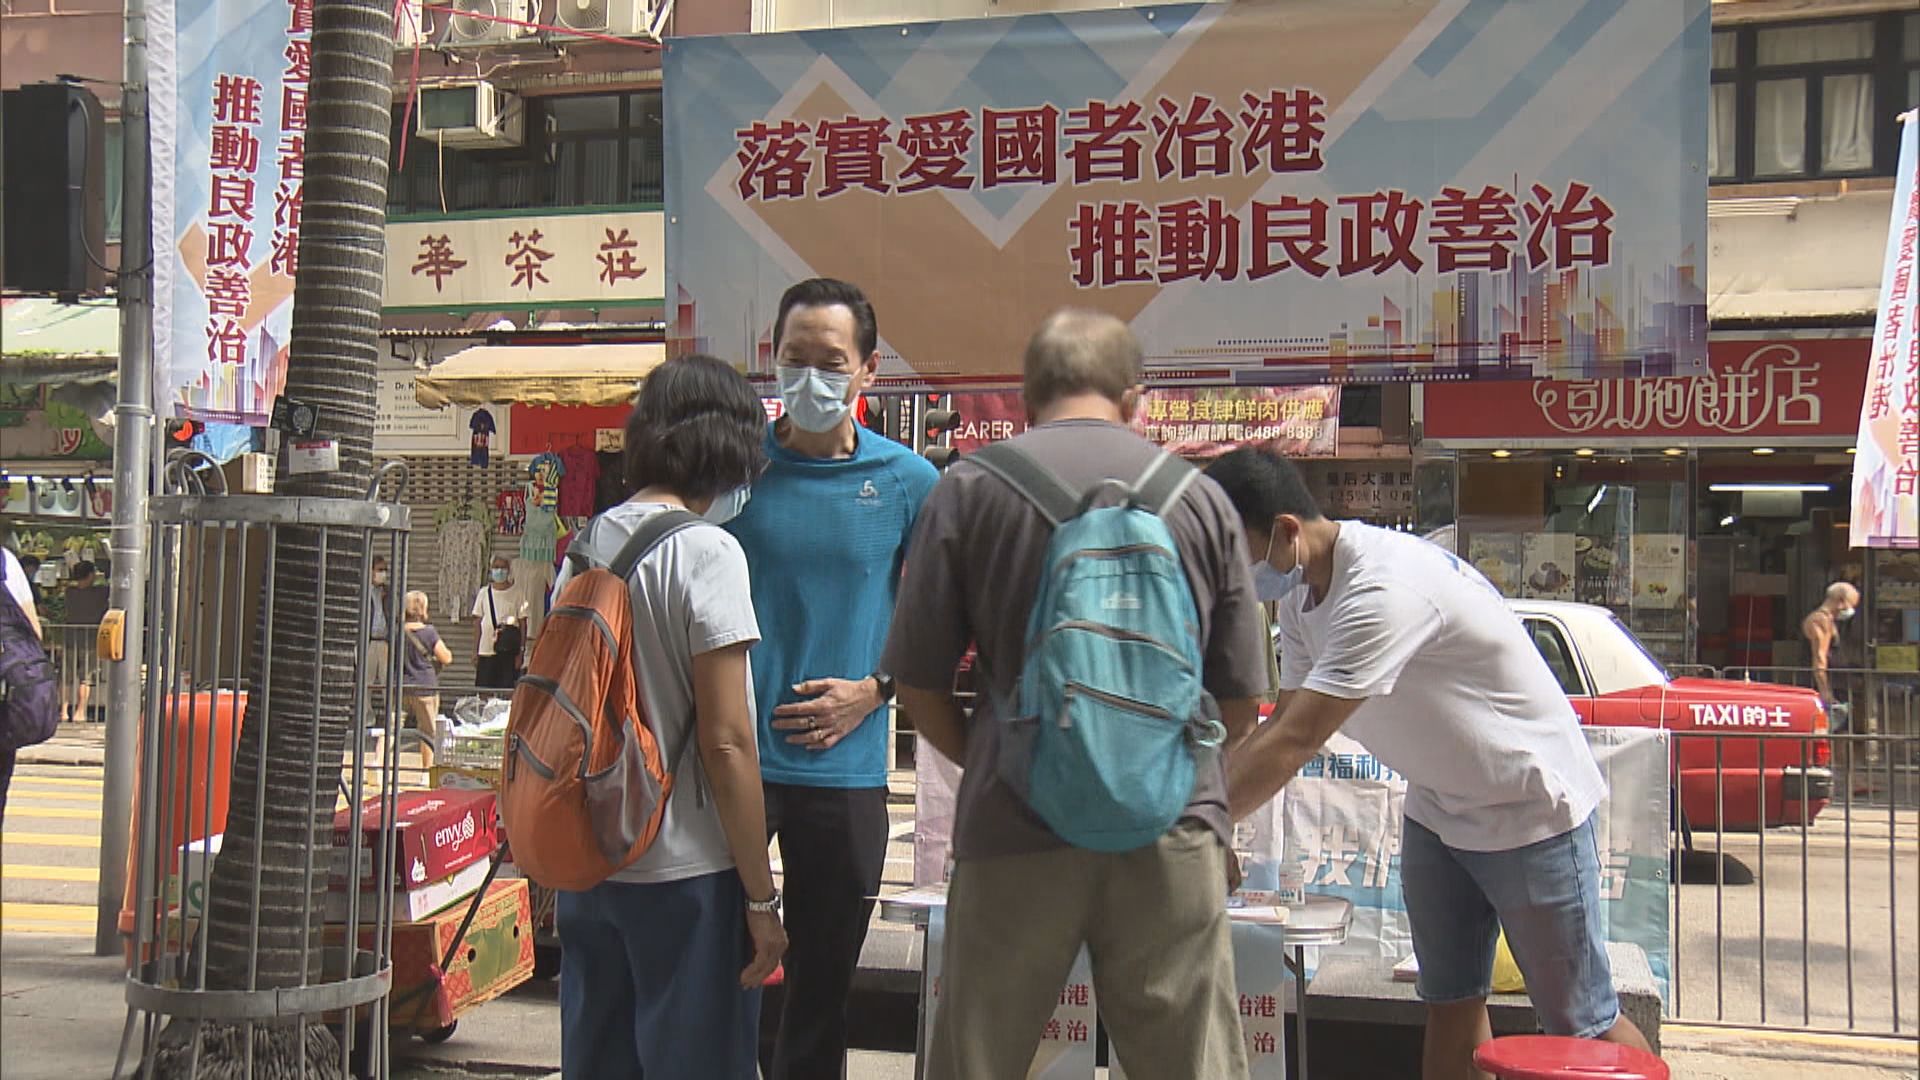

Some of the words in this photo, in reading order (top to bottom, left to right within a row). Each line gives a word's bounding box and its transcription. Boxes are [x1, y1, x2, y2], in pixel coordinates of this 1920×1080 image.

[736, 88, 1325, 201] 落實愛國者治港
[206, 75, 264, 366] 推動良政善治
[1069, 180, 1614, 287] 推動良政善治
[411, 228, 647, 293] 華茶莊
[1146, 398, 1325, 422] 專營食肆鮮肉供應
[1689, 703, 1740, 726] TAXI
[1743, 705, 1792, 727] 的士
[435, 822, 464, 851] envy
